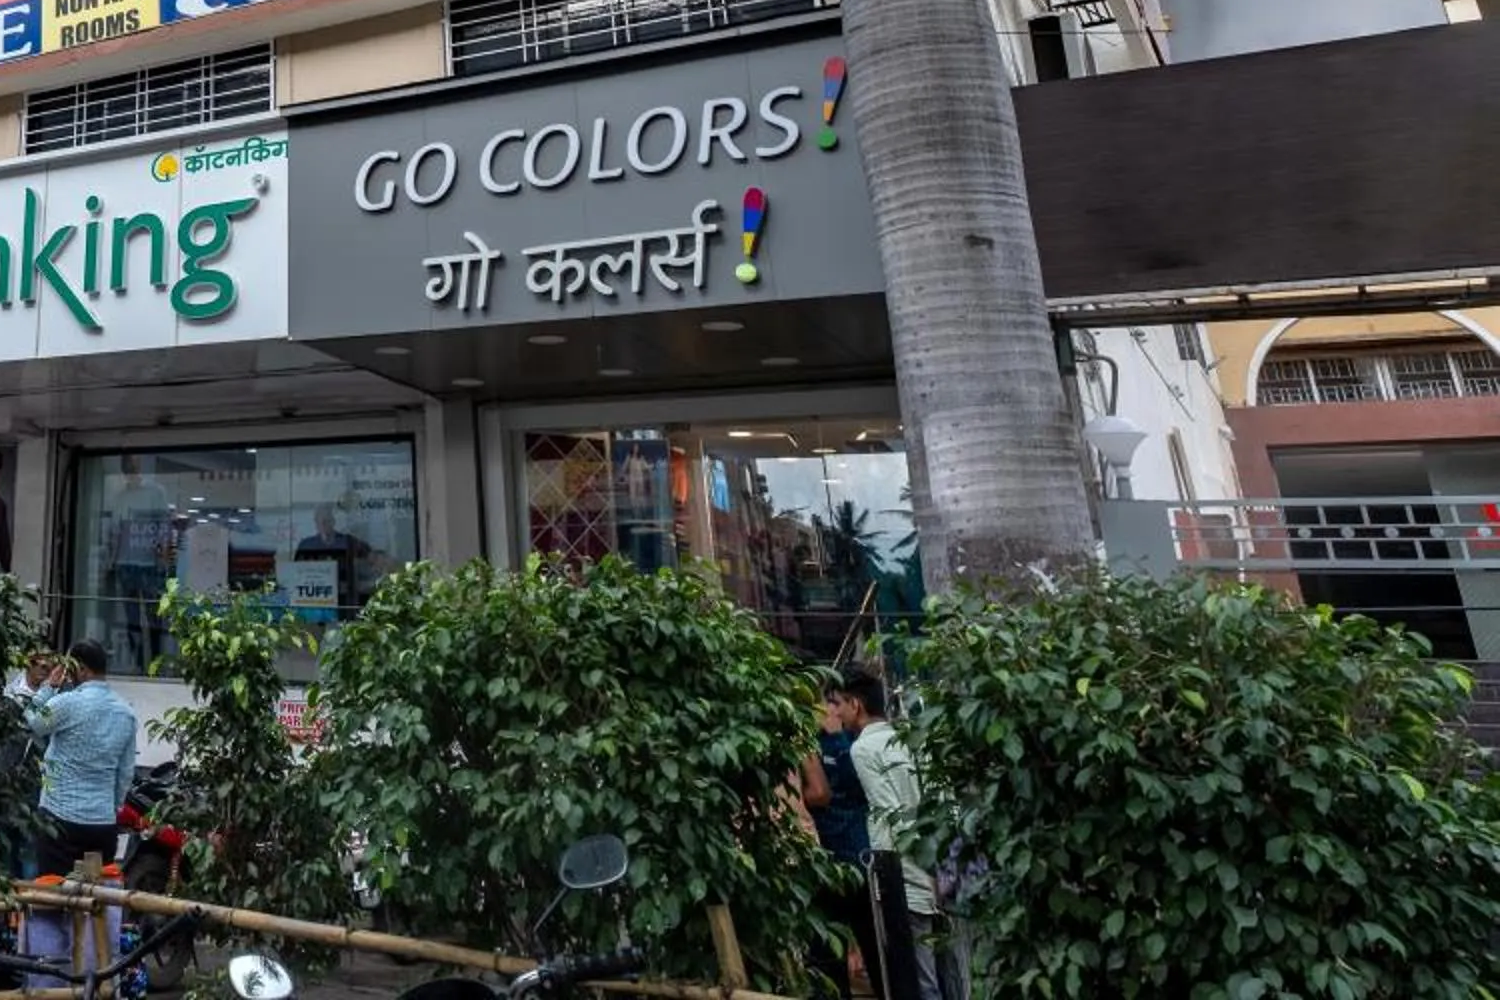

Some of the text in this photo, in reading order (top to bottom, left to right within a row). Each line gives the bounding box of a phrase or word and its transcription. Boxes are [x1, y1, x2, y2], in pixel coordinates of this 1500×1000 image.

[60, 9, 141, 48] ROOMS
[184, 136, 289, 173] कॉटनकिंग
[355, 142, 457, 212] GO
[423, 231, 503, 310] गो
